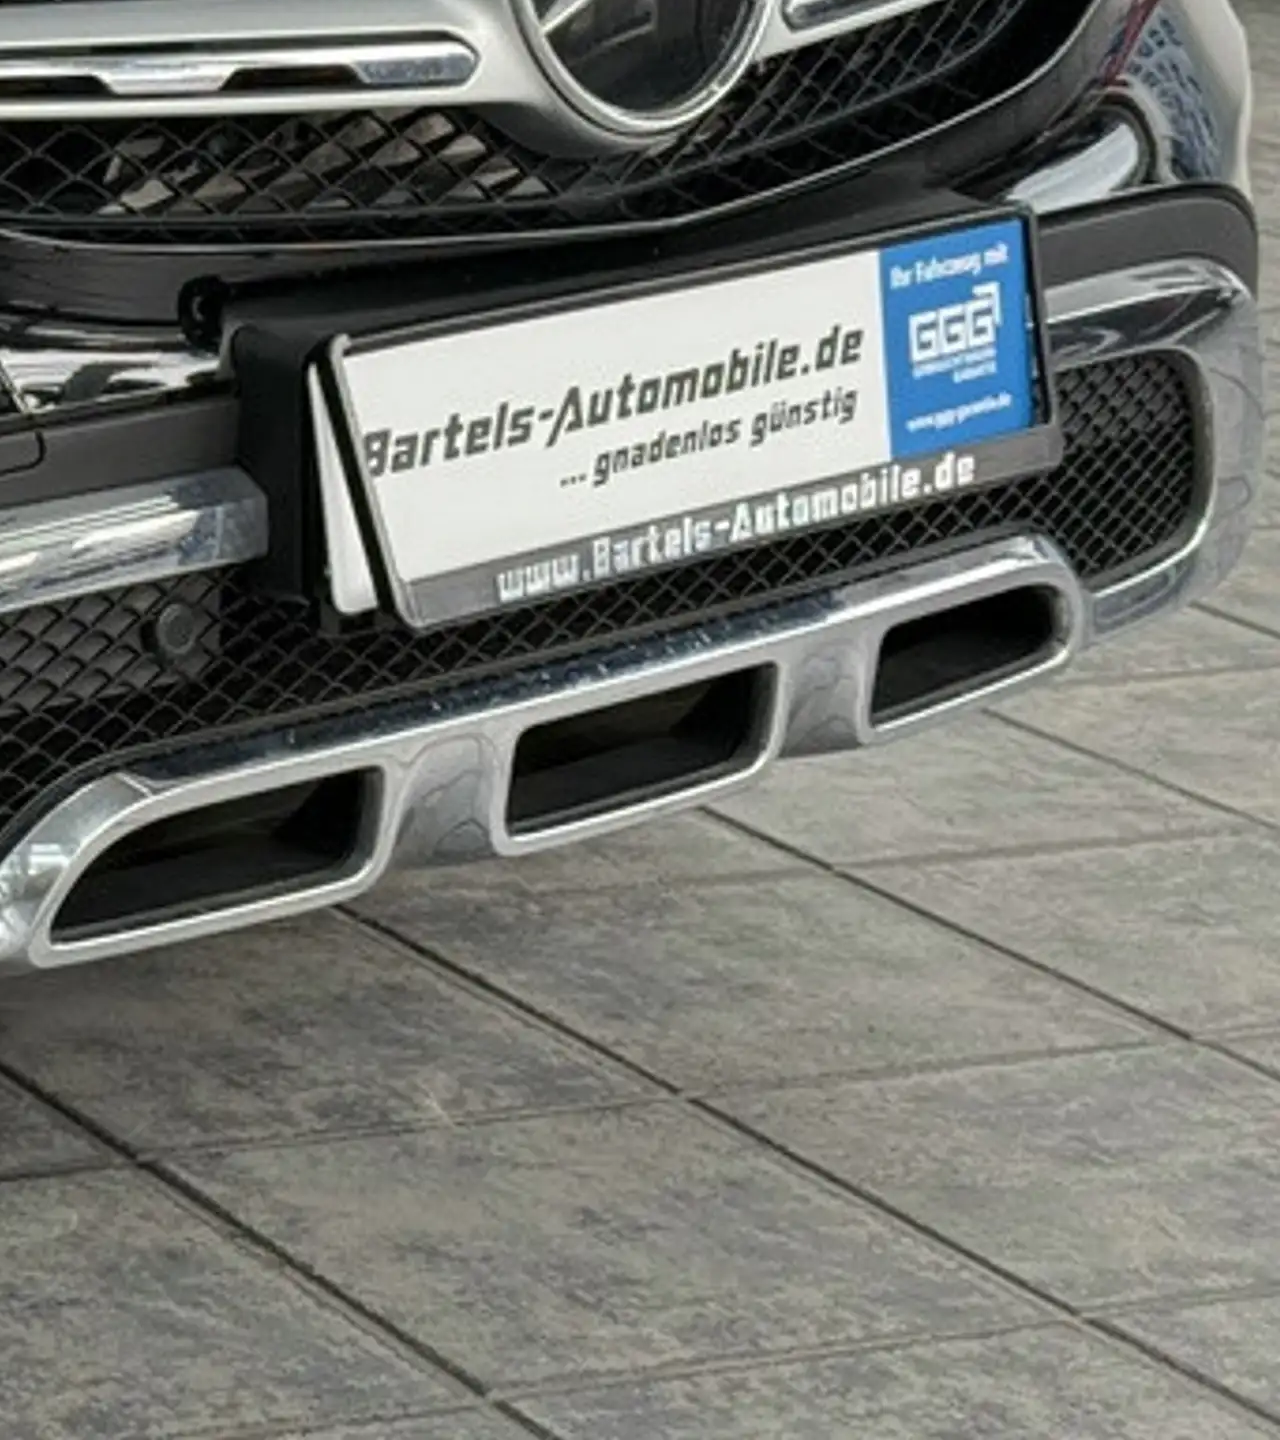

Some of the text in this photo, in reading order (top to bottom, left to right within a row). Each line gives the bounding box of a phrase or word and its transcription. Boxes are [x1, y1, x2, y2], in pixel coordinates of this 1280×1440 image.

[363, 324, 865, 477] Bartels-Automobile.de
[750, 386, 860, 448] günstig
[495, 451, 977, 603] www.Bartels-Automobile.de
